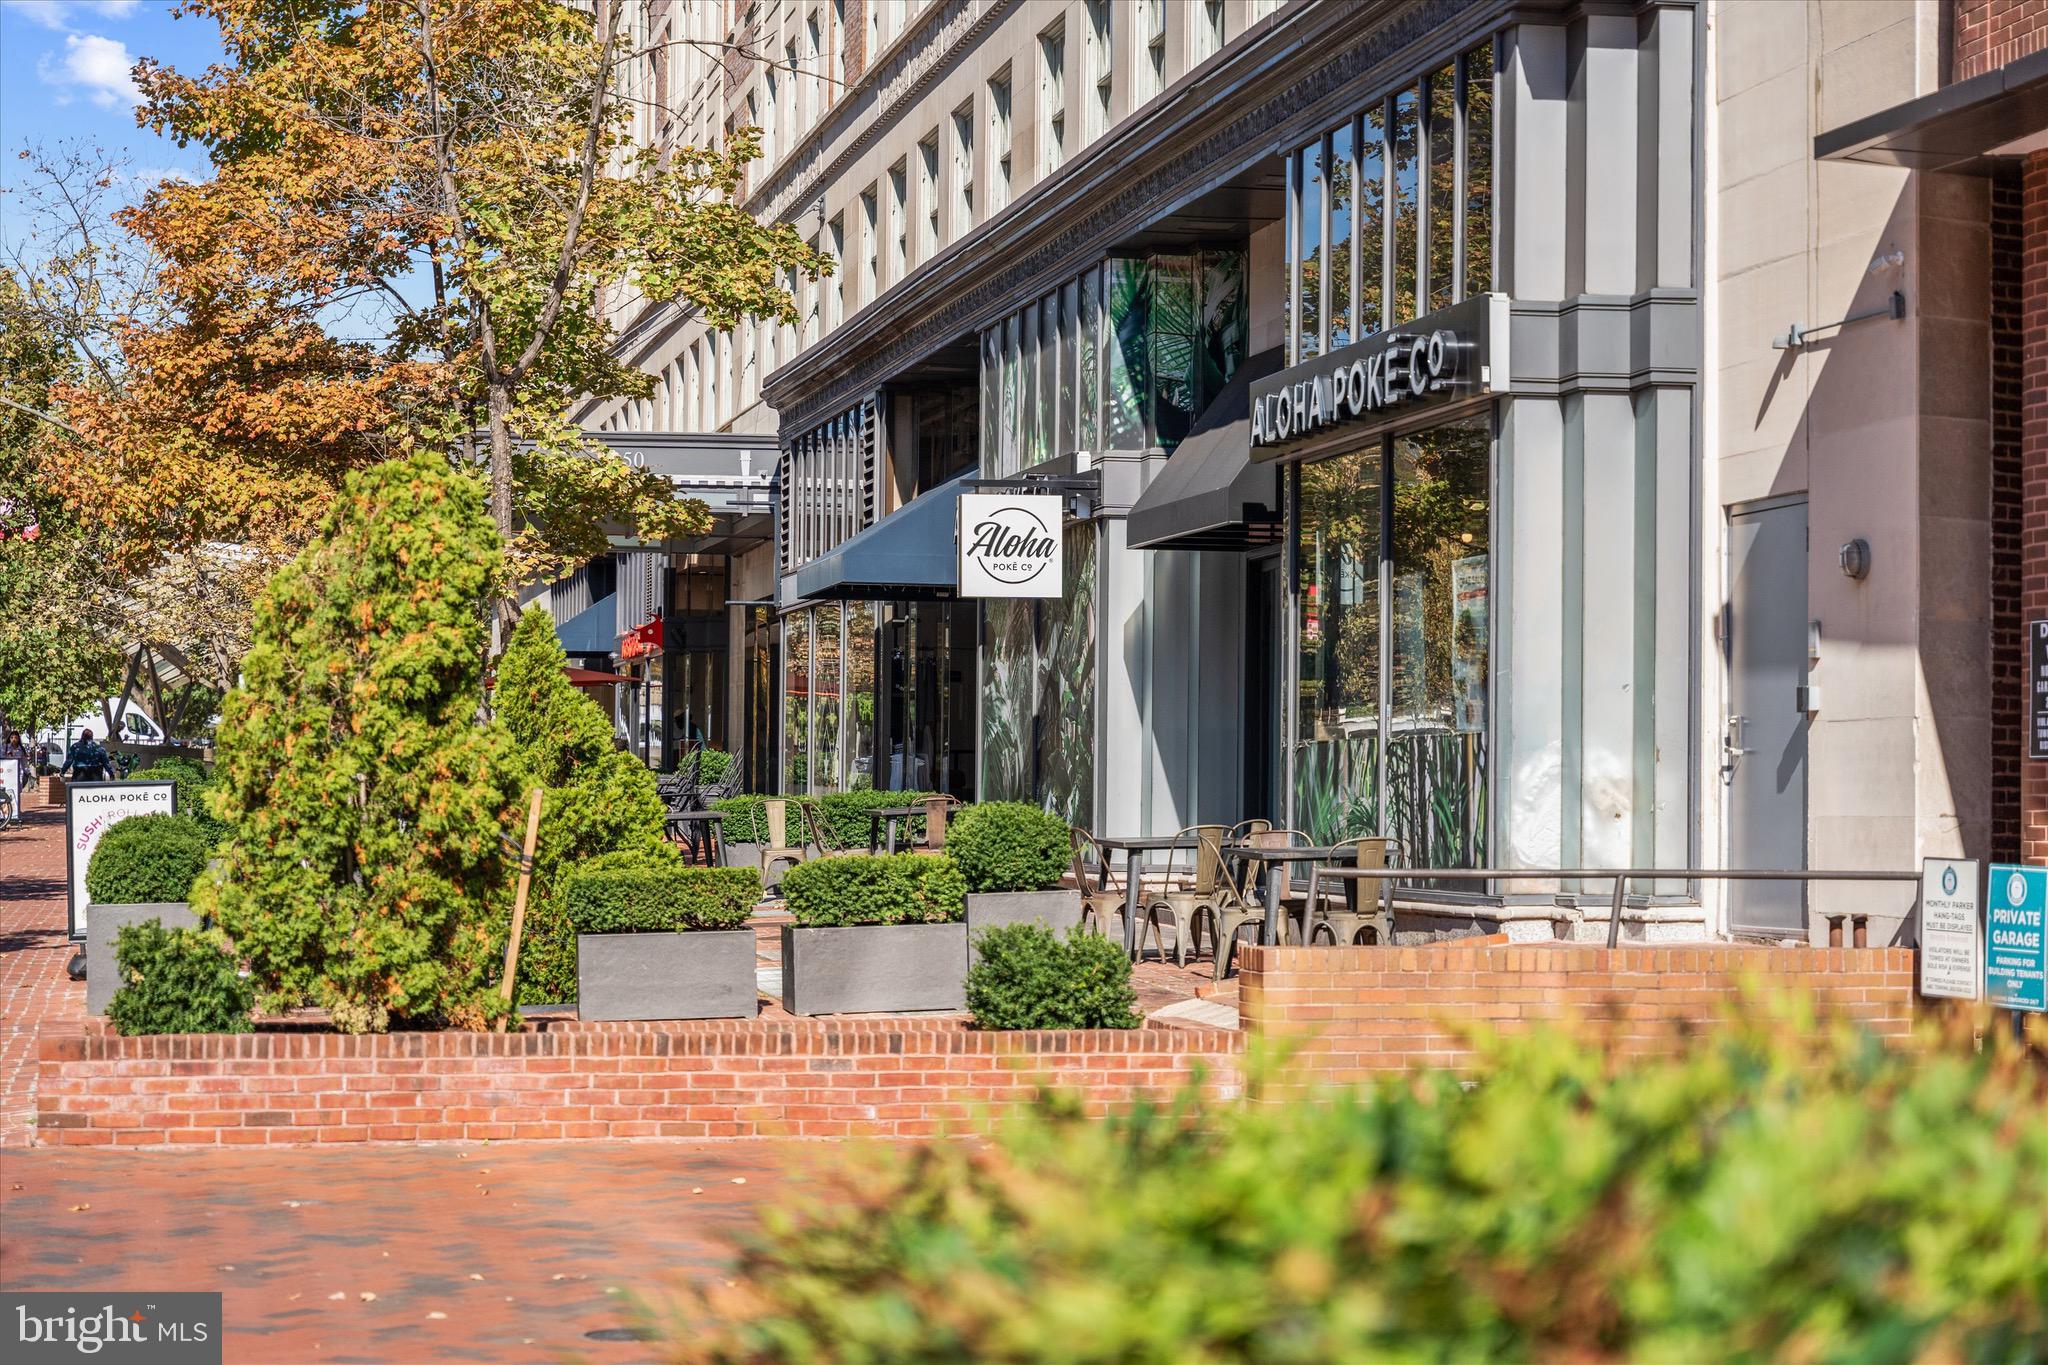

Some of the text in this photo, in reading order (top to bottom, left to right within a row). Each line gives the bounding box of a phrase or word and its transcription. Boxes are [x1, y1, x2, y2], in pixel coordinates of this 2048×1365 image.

[1251, 374, 1324, 448] ALOHA
[966, 521, 1058, 559] Aloha
[78, 794, 116, 803] ALOHA
[1926, 900, 1974, 910] MONTHLY PARKER
[1993, 909, 2041, 927] PRIVATE
[1992, 930, 2040, 947] GARAGE
[1996, 956, 2036, 967] PARKING FOR
[1988, 967, 2044, 979] BUILDING TENANTS
[2006, 979, 2024, 989] ONLY
